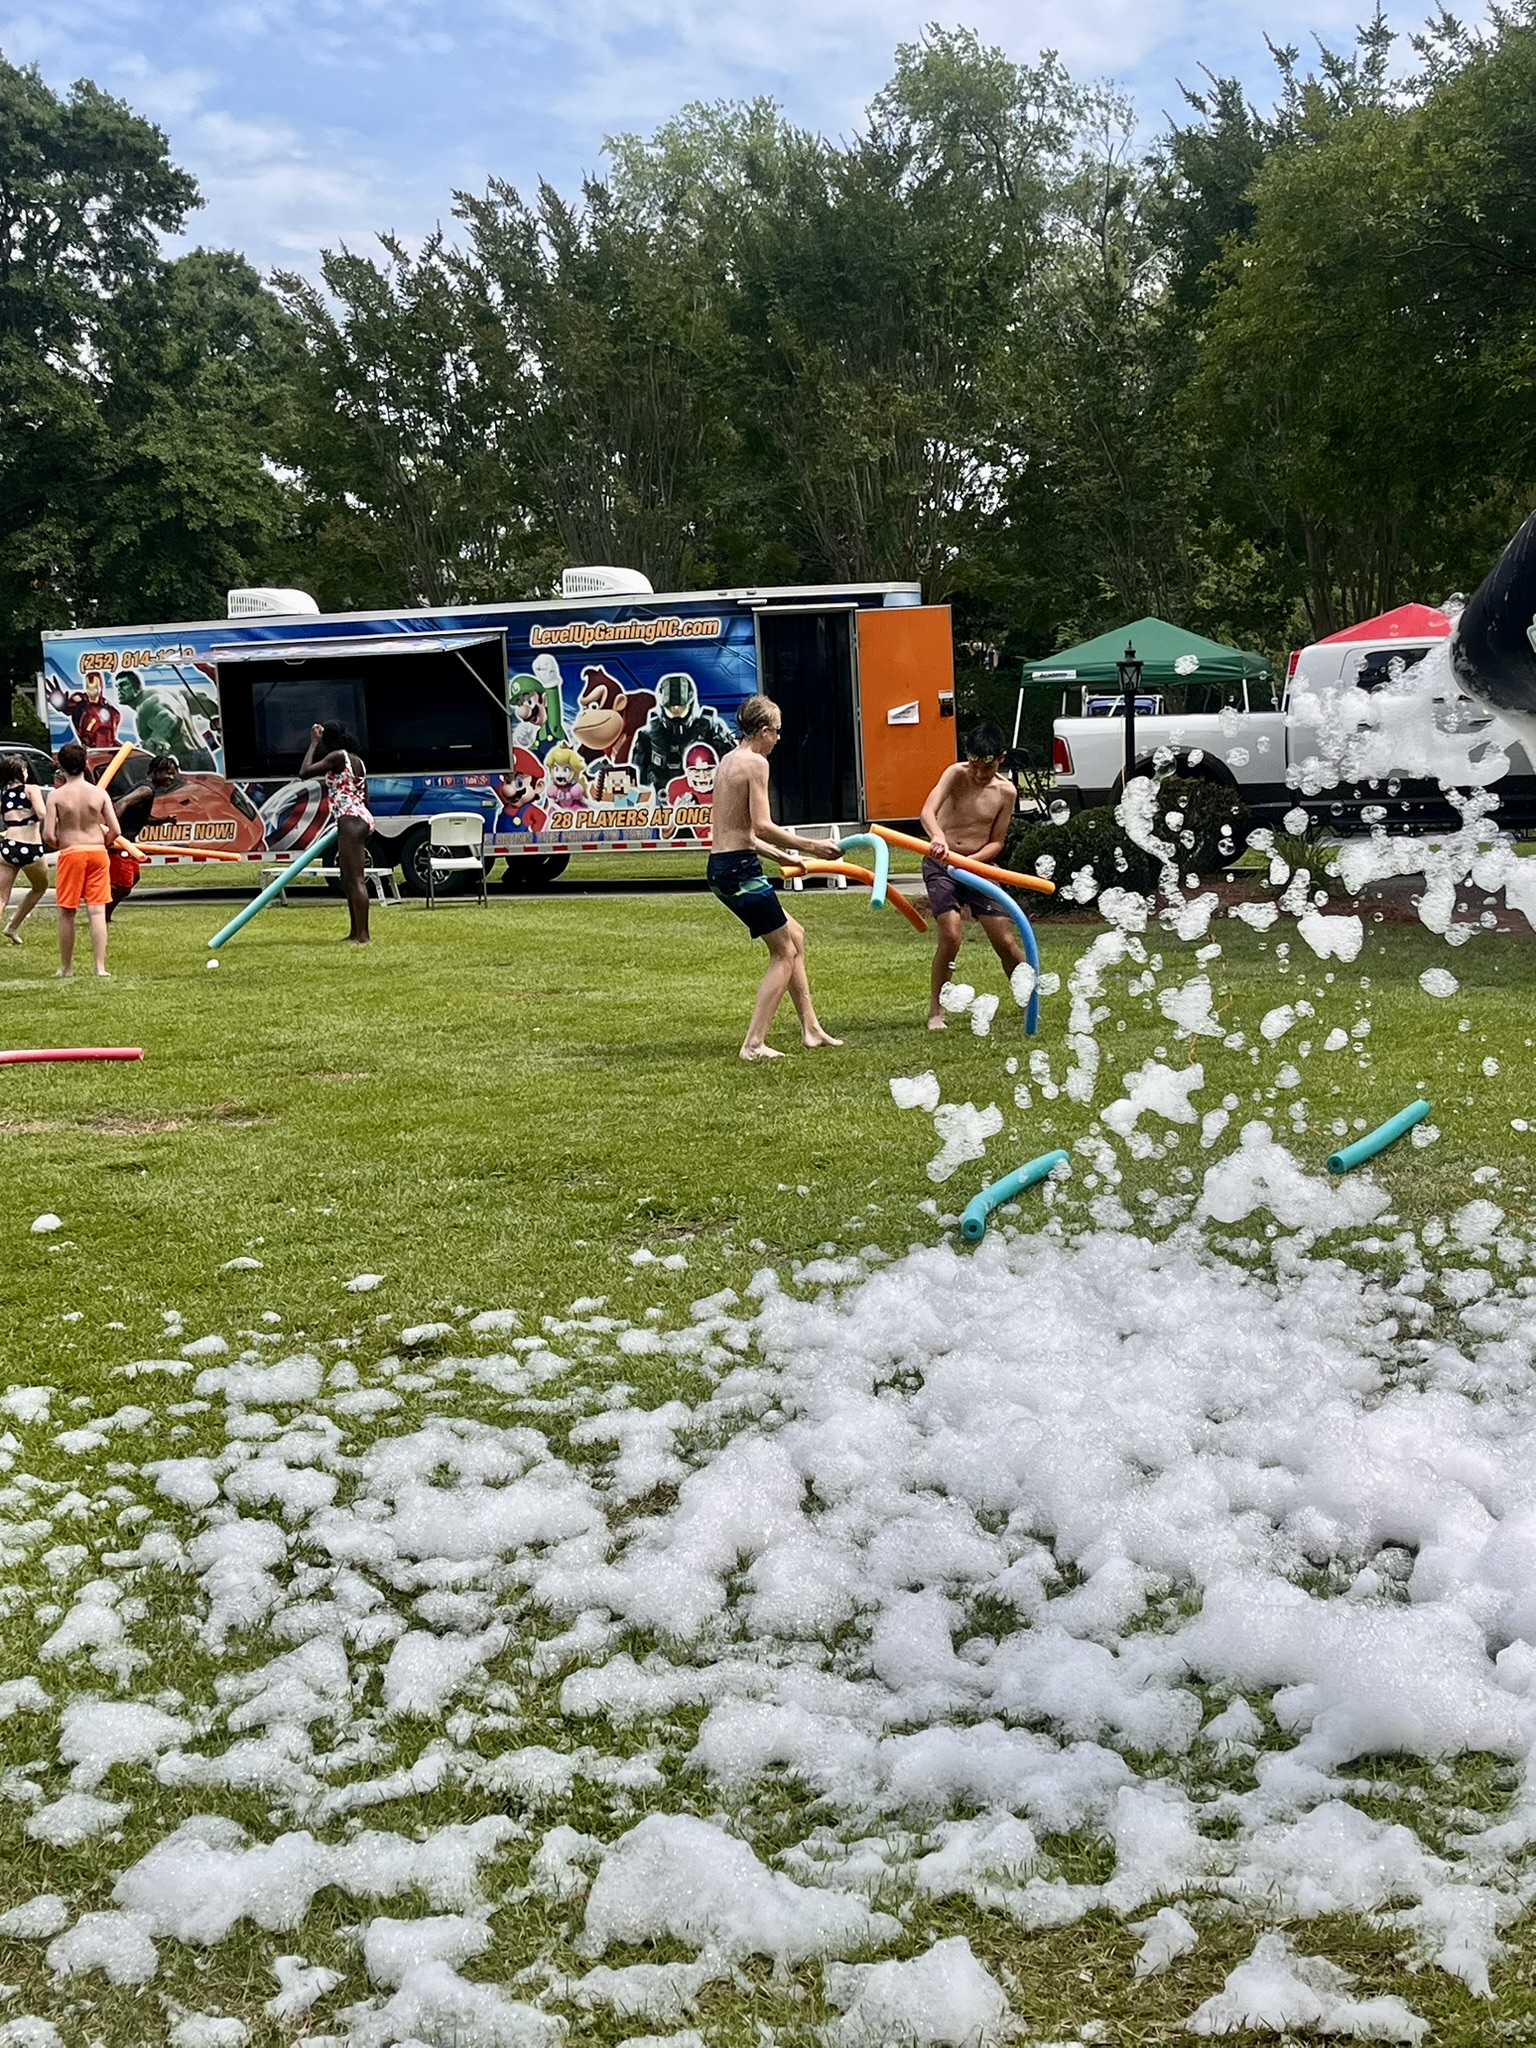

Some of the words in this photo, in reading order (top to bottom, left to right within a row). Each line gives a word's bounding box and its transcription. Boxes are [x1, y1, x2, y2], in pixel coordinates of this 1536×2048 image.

[532, 620, 719, 645] LevelUpGamingNC.com
[80, 652, 118, 673] (252)
[121, 647, 194, 668] 814-1
[551, 811, 573, 829] 28
[576, 808, 648, 829] PLAYERS
[651, 807, 673, 825] AT
[139, 823, 192, 841] ONLINE
[194, 821, 235, 841] NOW!
